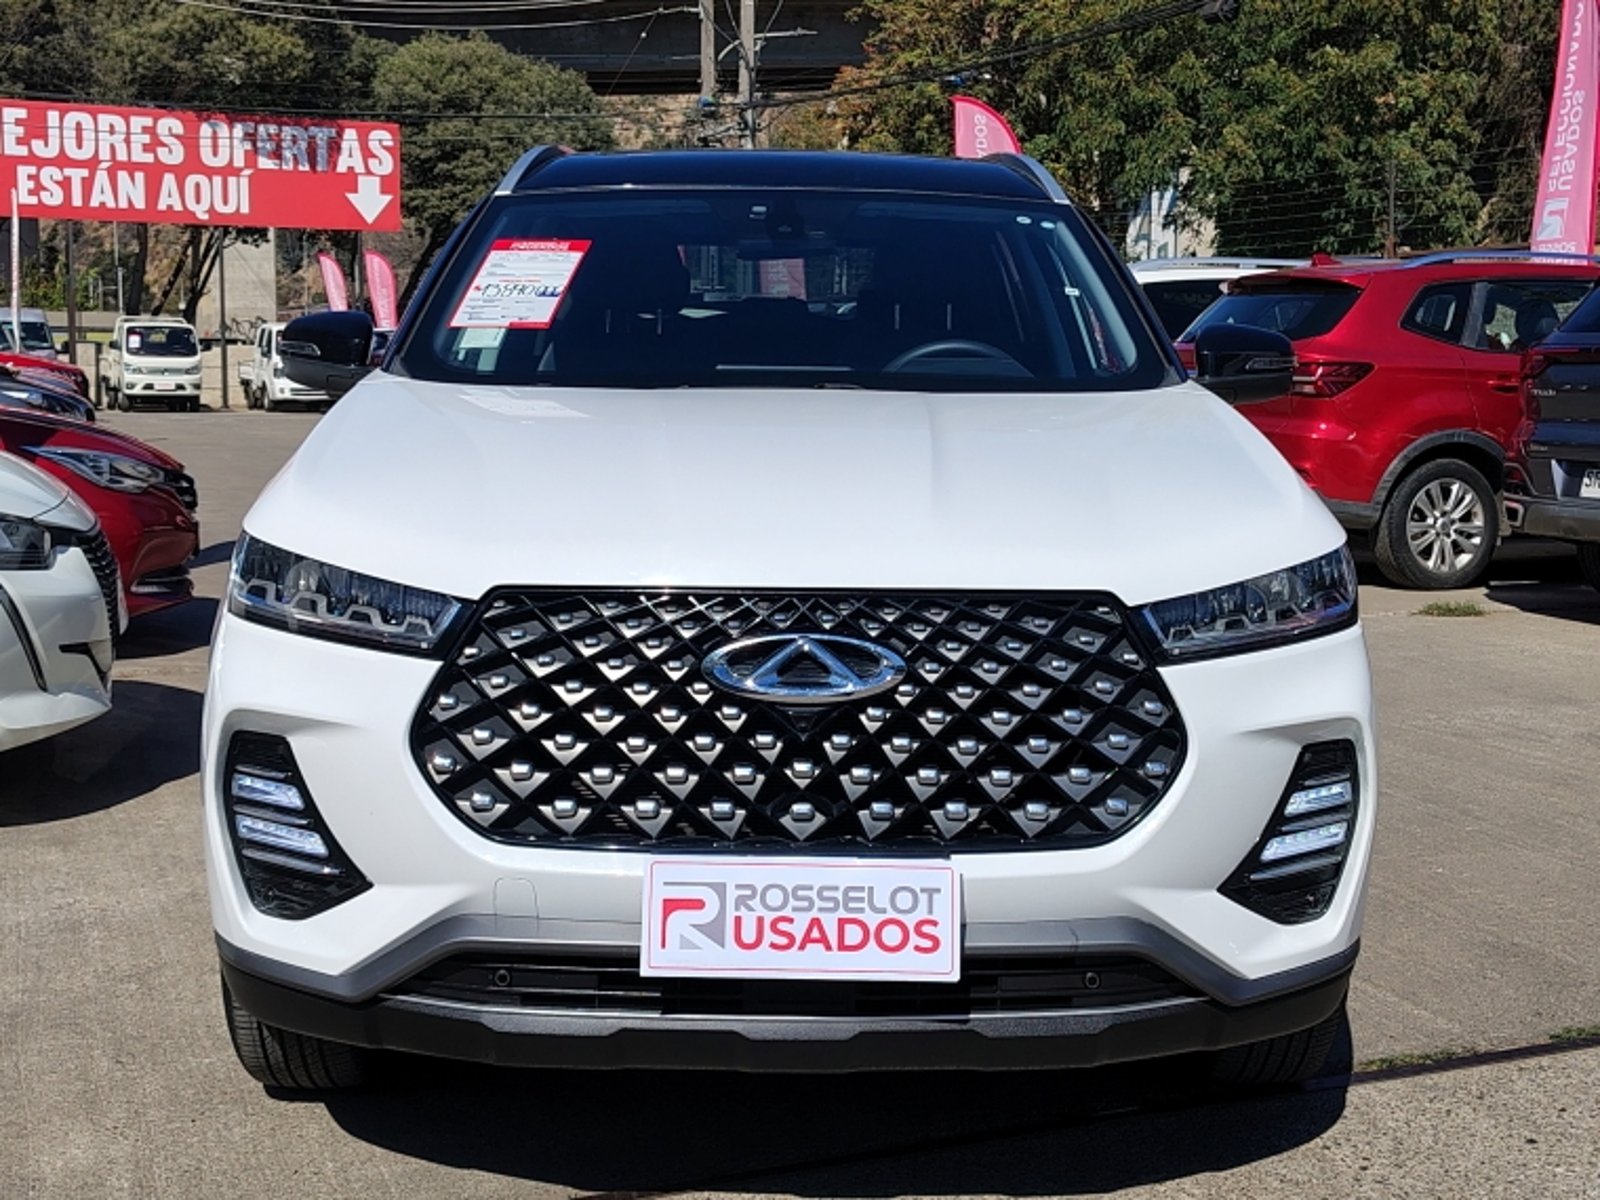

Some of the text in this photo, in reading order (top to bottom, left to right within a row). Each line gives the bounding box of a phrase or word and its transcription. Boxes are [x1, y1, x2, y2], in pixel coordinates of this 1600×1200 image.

[0, 107, 395, 177] EJORES OFERTAS
[15, 161, 255, 220] ESTÁN AQUÍ
[733, 882, 942, 916] ROSSELOT
[732, 915, 942, 955] USADOS
